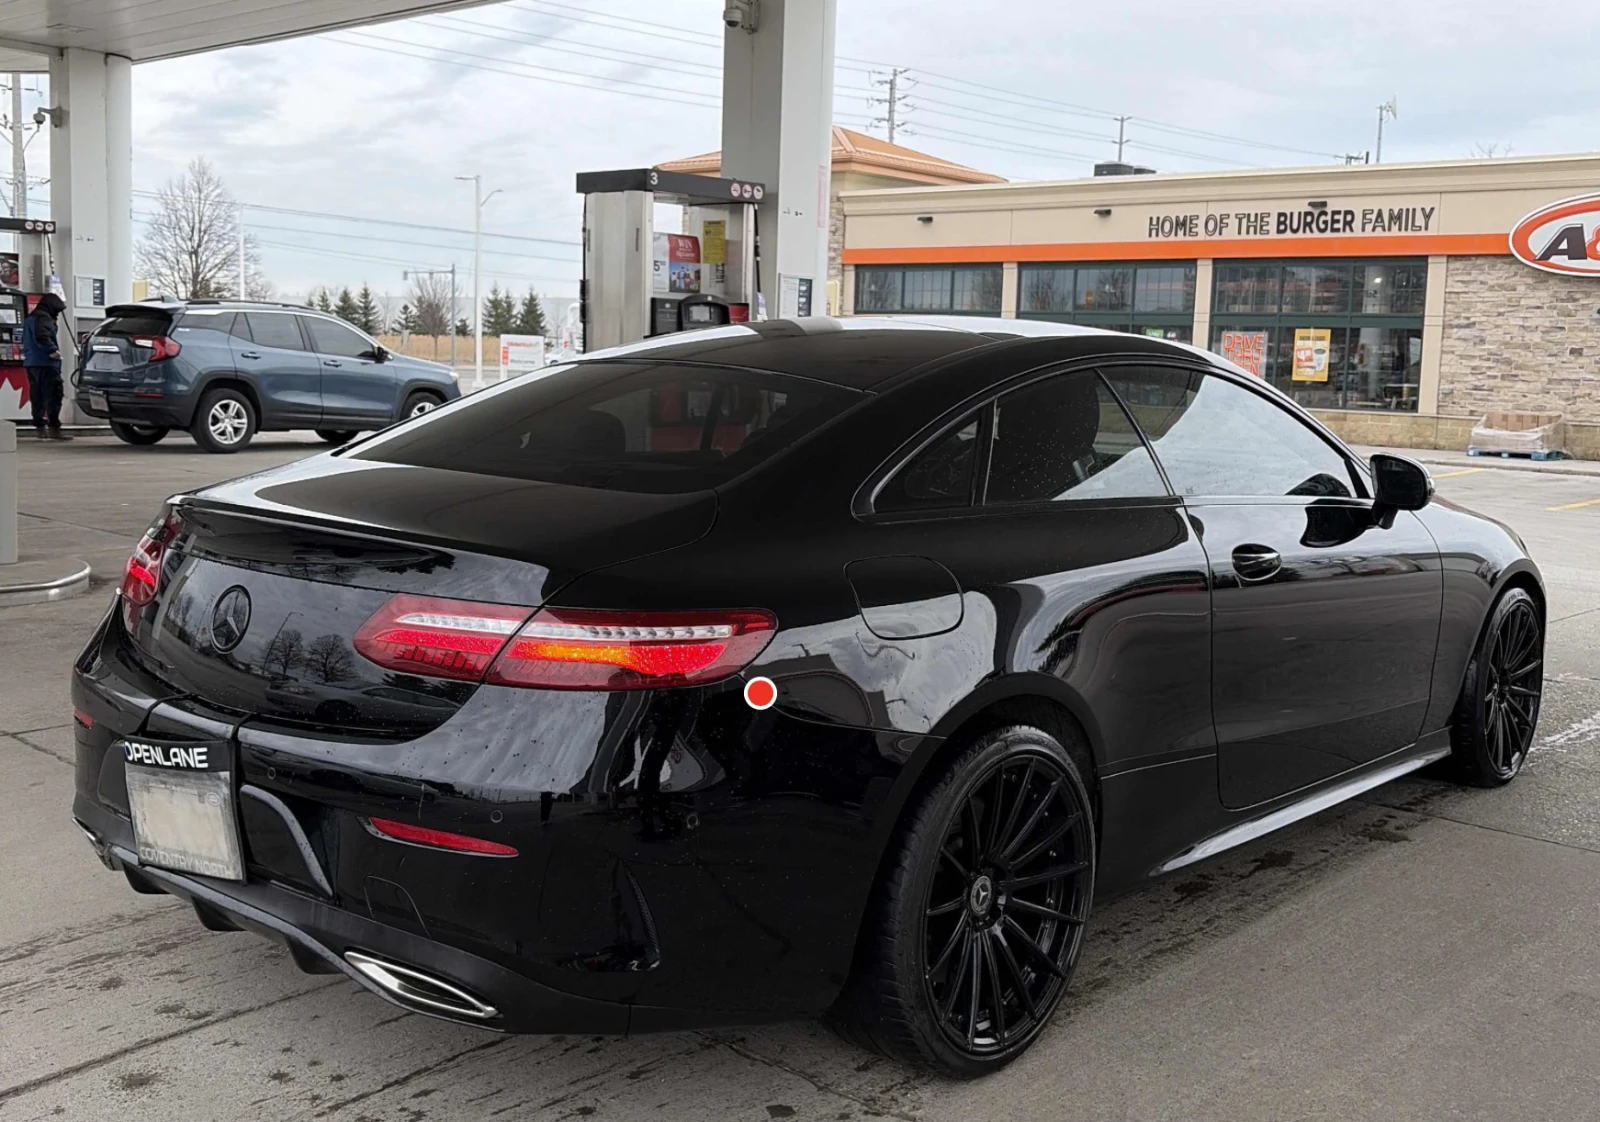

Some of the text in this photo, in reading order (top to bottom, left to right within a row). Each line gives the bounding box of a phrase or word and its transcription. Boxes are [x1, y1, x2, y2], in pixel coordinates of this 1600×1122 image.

[650, 172, 659, 185] 3
[1148, 207, 1435, 238] HOME OF THE BURGER FAMILY
[1223, 333, 1265, 350] DRIVE
[1226, 348, 1262, 364] THRU
[124, 741, 208, 768] OPENLANE
[140, 847, 234, 878] COVENTRY NORTH
